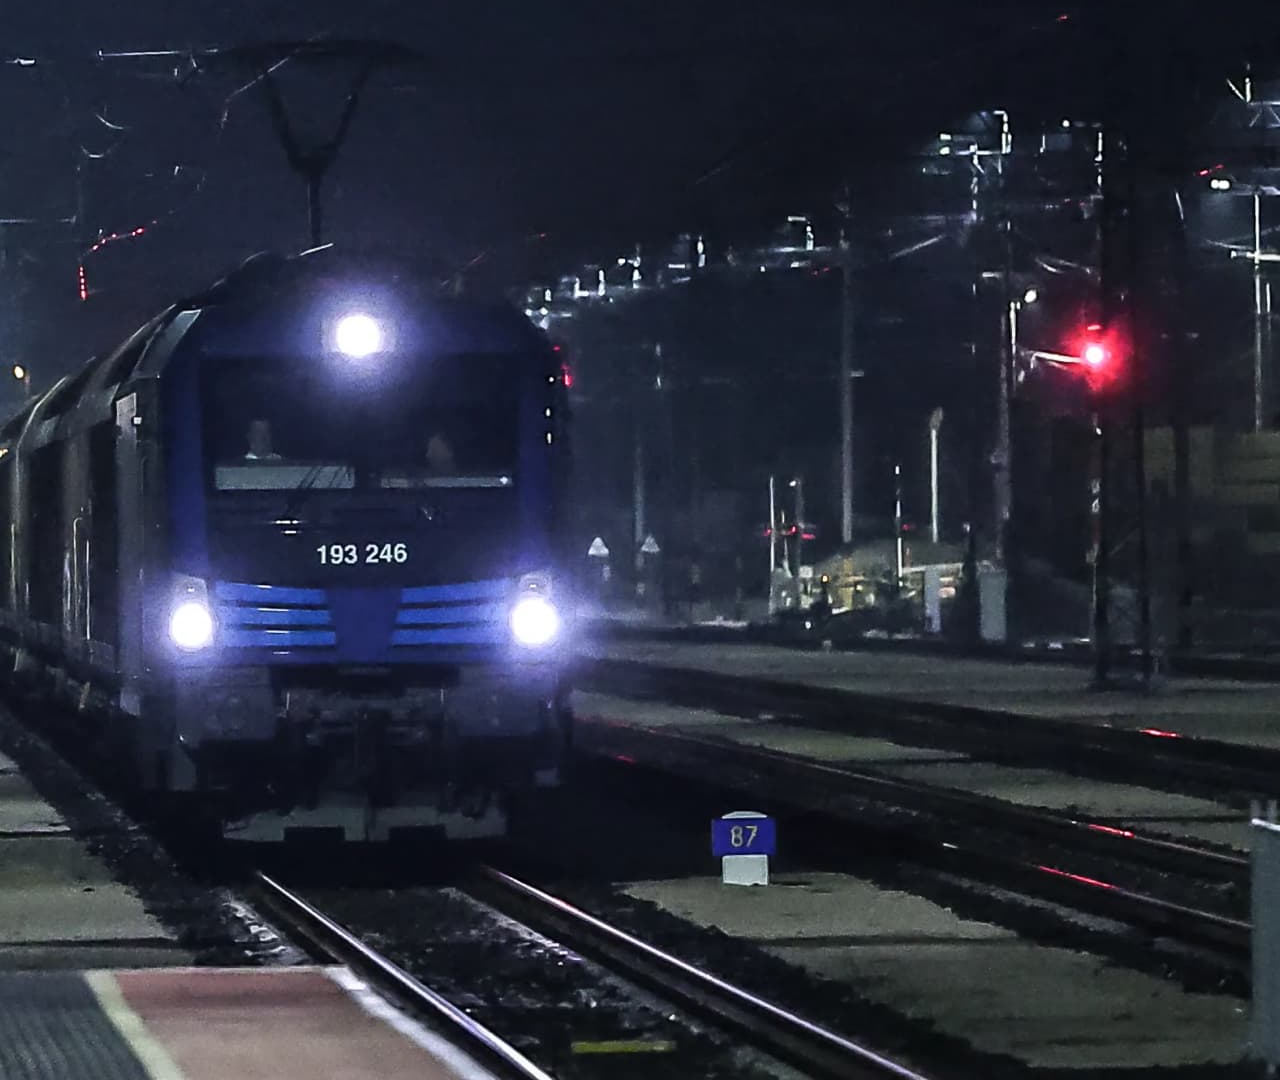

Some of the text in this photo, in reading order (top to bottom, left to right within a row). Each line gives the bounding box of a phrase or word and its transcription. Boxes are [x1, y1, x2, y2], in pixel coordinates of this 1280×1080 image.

[317, 543, 407, 564] 193 246
[730, 825, 758, 847] 87
